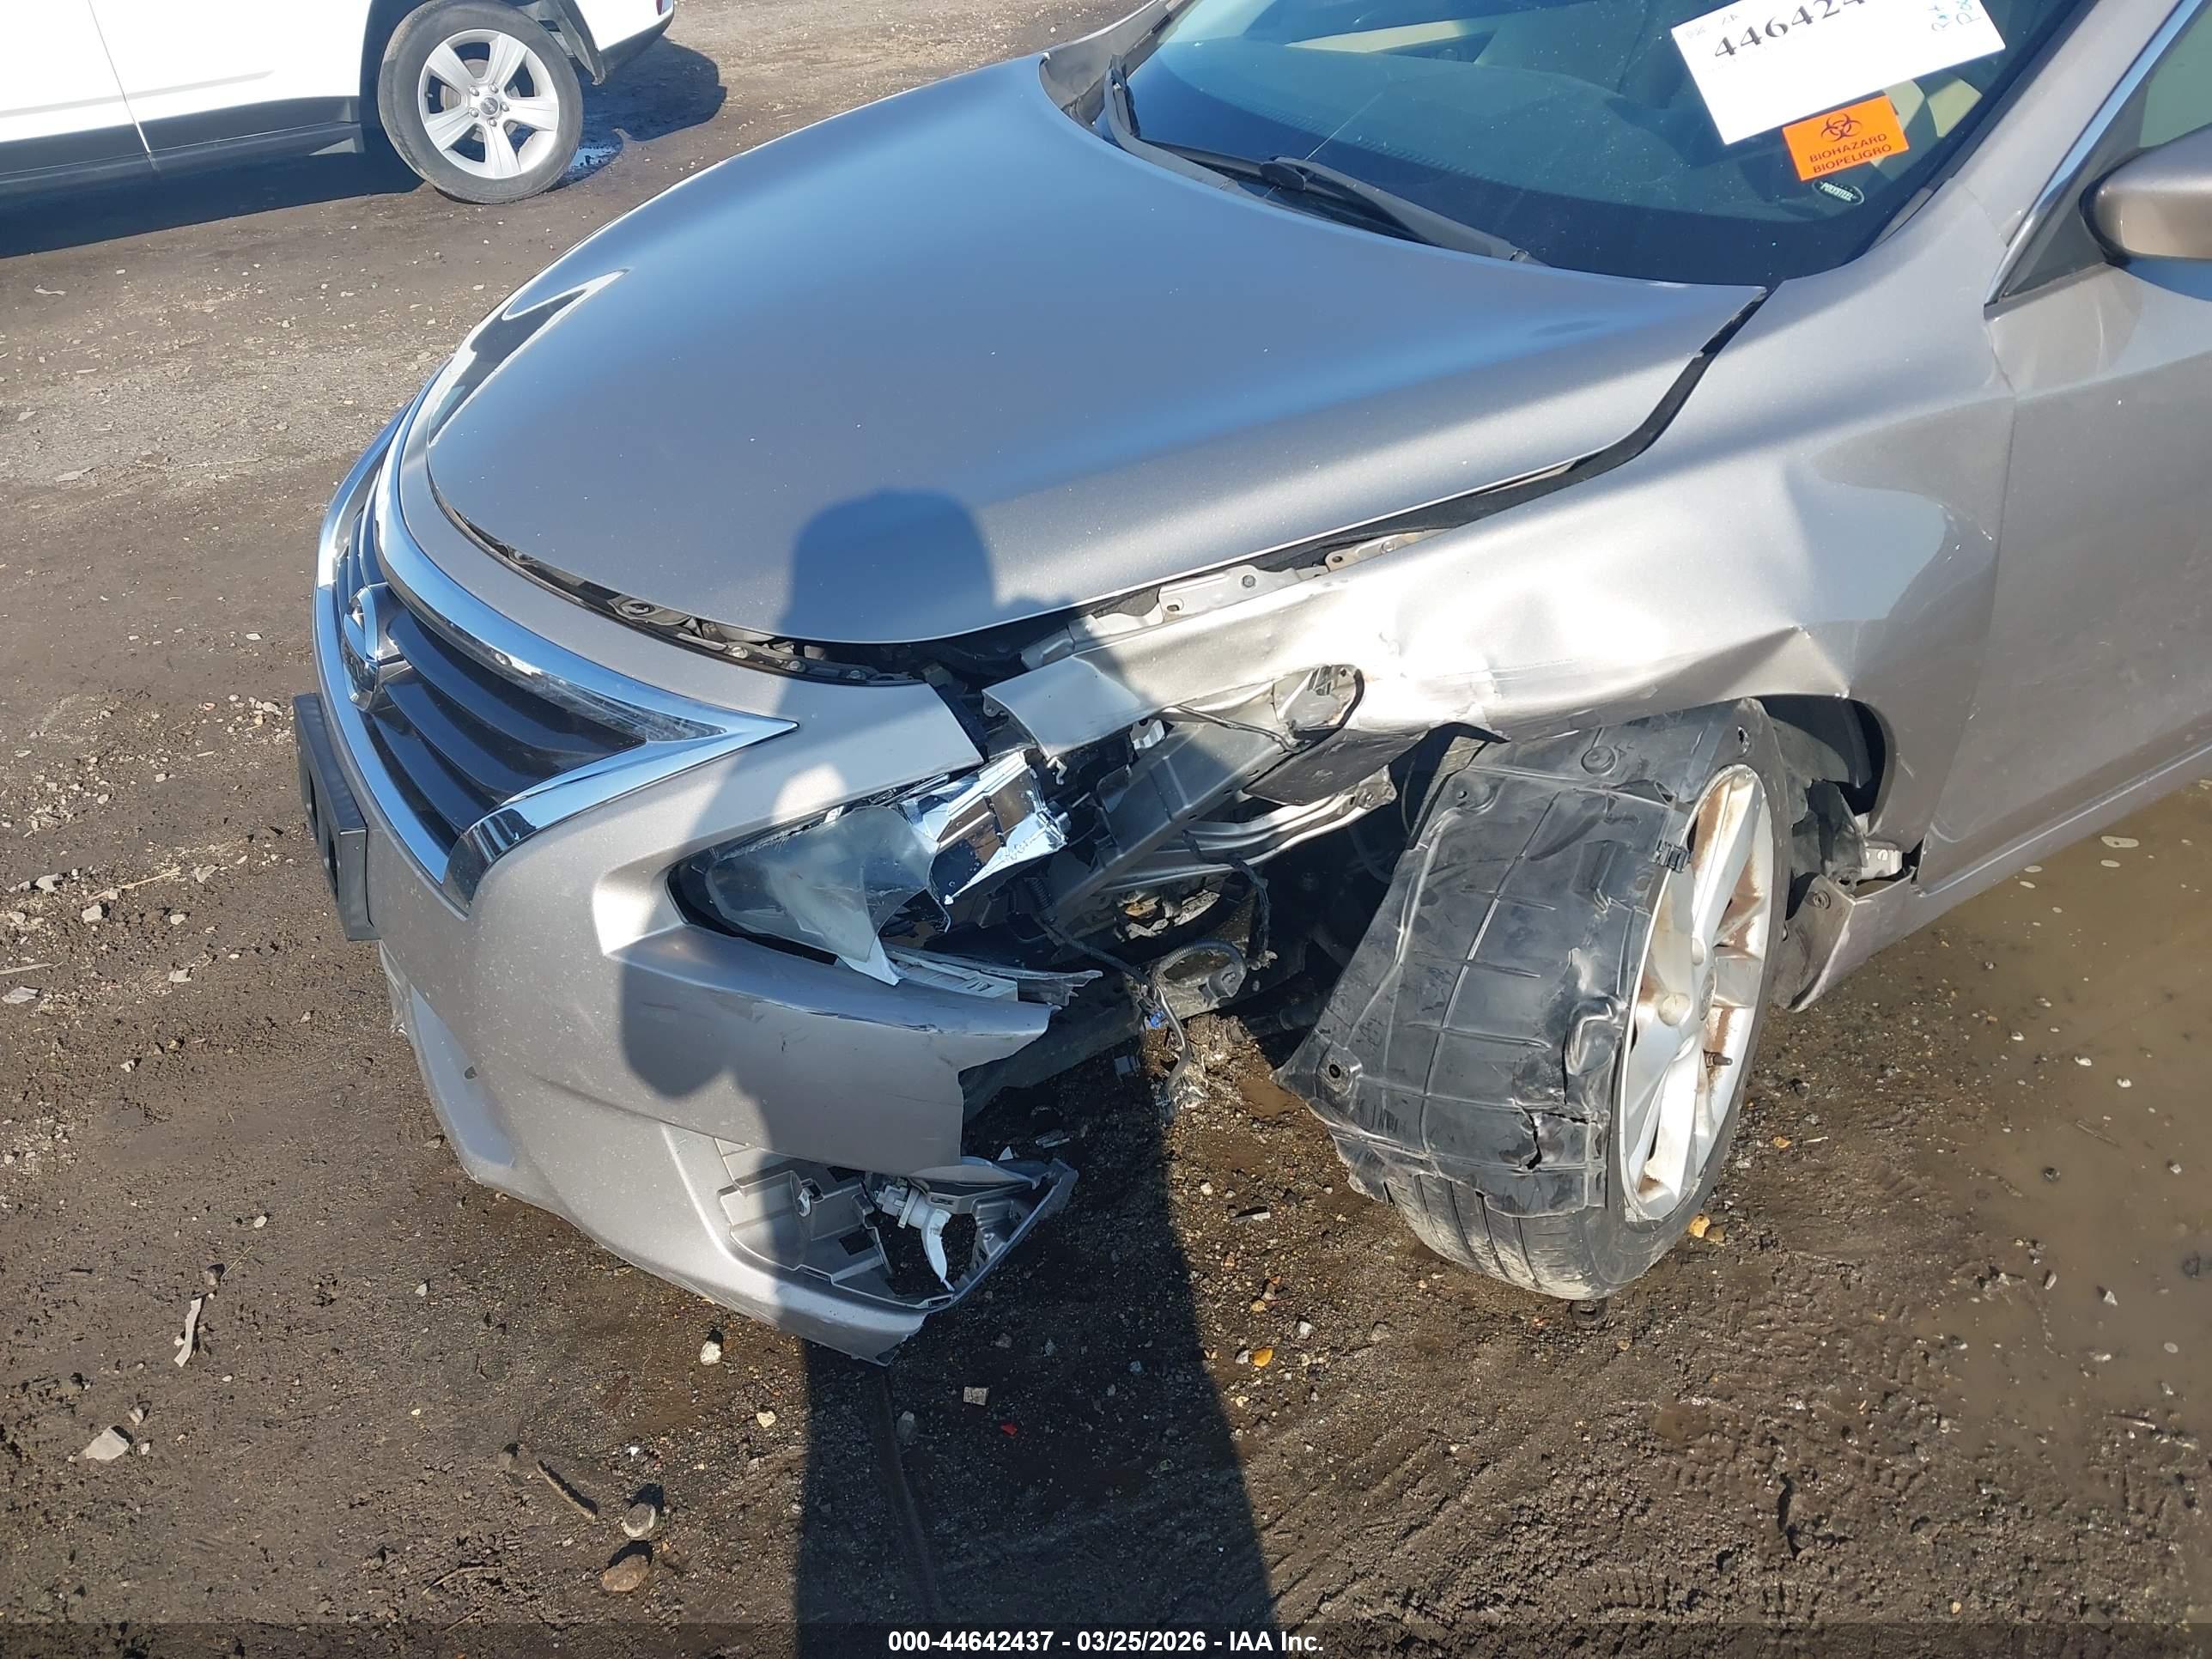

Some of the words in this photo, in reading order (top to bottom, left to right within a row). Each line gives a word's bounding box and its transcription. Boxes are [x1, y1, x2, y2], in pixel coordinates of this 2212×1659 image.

[1715, 0, 1864, 57] 44642
[1809, 133, 1887, 162] BIOHAZARD
[1813, 143, 1892, 173] BIOPELIGRO
